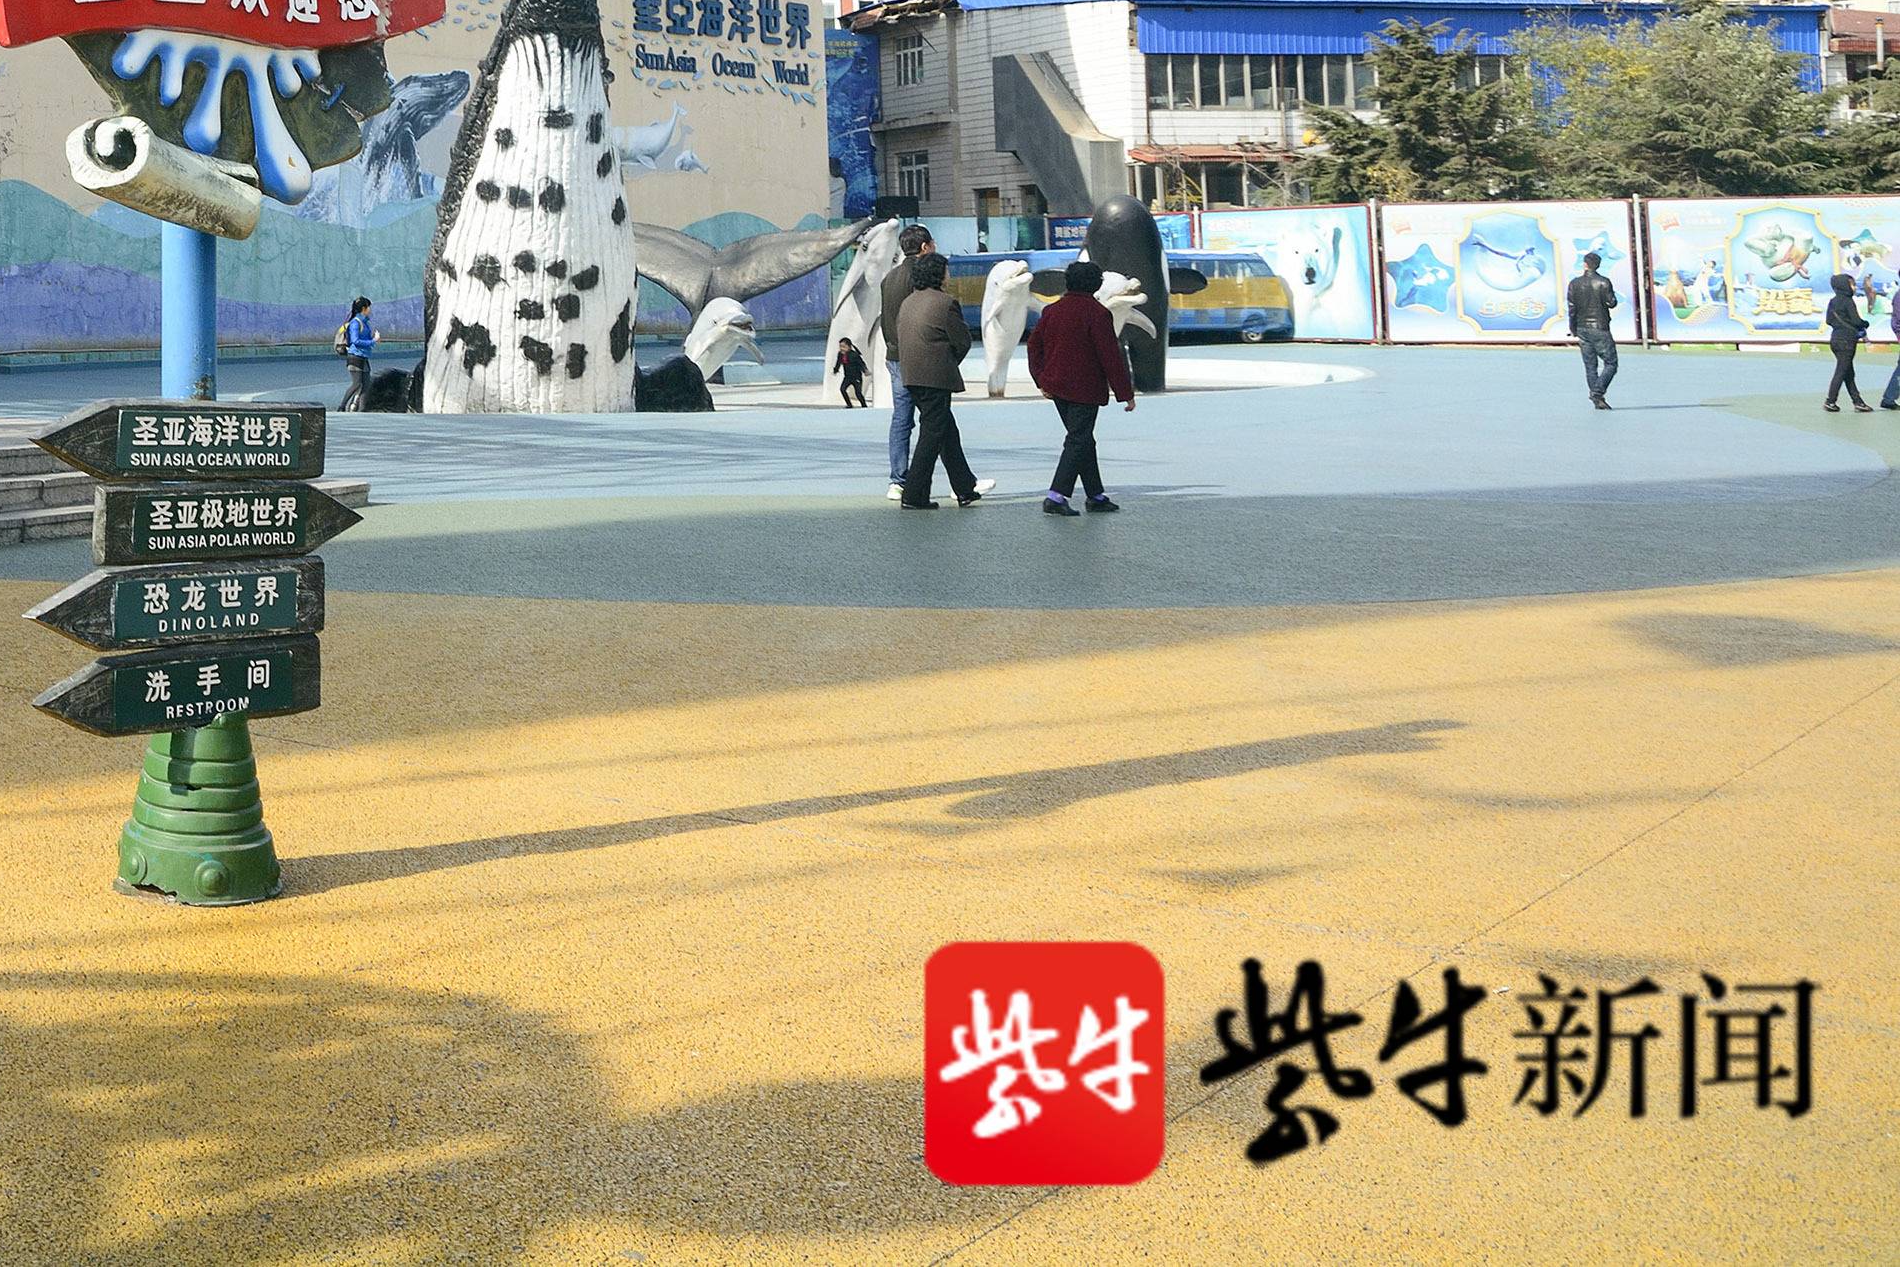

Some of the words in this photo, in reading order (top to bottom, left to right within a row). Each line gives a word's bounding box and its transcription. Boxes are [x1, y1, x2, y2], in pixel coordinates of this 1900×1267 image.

[712, 52, 756, 79] Ocean
[772, 60, 809, 86] World
[132, 415, 292, 448] 圣亚海洋世界
[130, 453, 160, 466] SUN
[164, 453, 194, 466] ASIA
[198, 453, 242, 466] OCEAN
[244, 453, 290, 466] WORLD
[149, 496, 298, 531] 圣亚极地世界
[148, 535, 175, 550] SUN
[178, 535, 207, 549] ASIA
[209, 533, 250, 548] POLAR
[252, 530, 295, 545] WORLD
[142, 576, 279, 615] 恐龙世界
[158, 613, 260, 632] DINOLAND
[145, 659, 270, 702] 洗手间
[166, 697, 250, 719] RESTROOM
